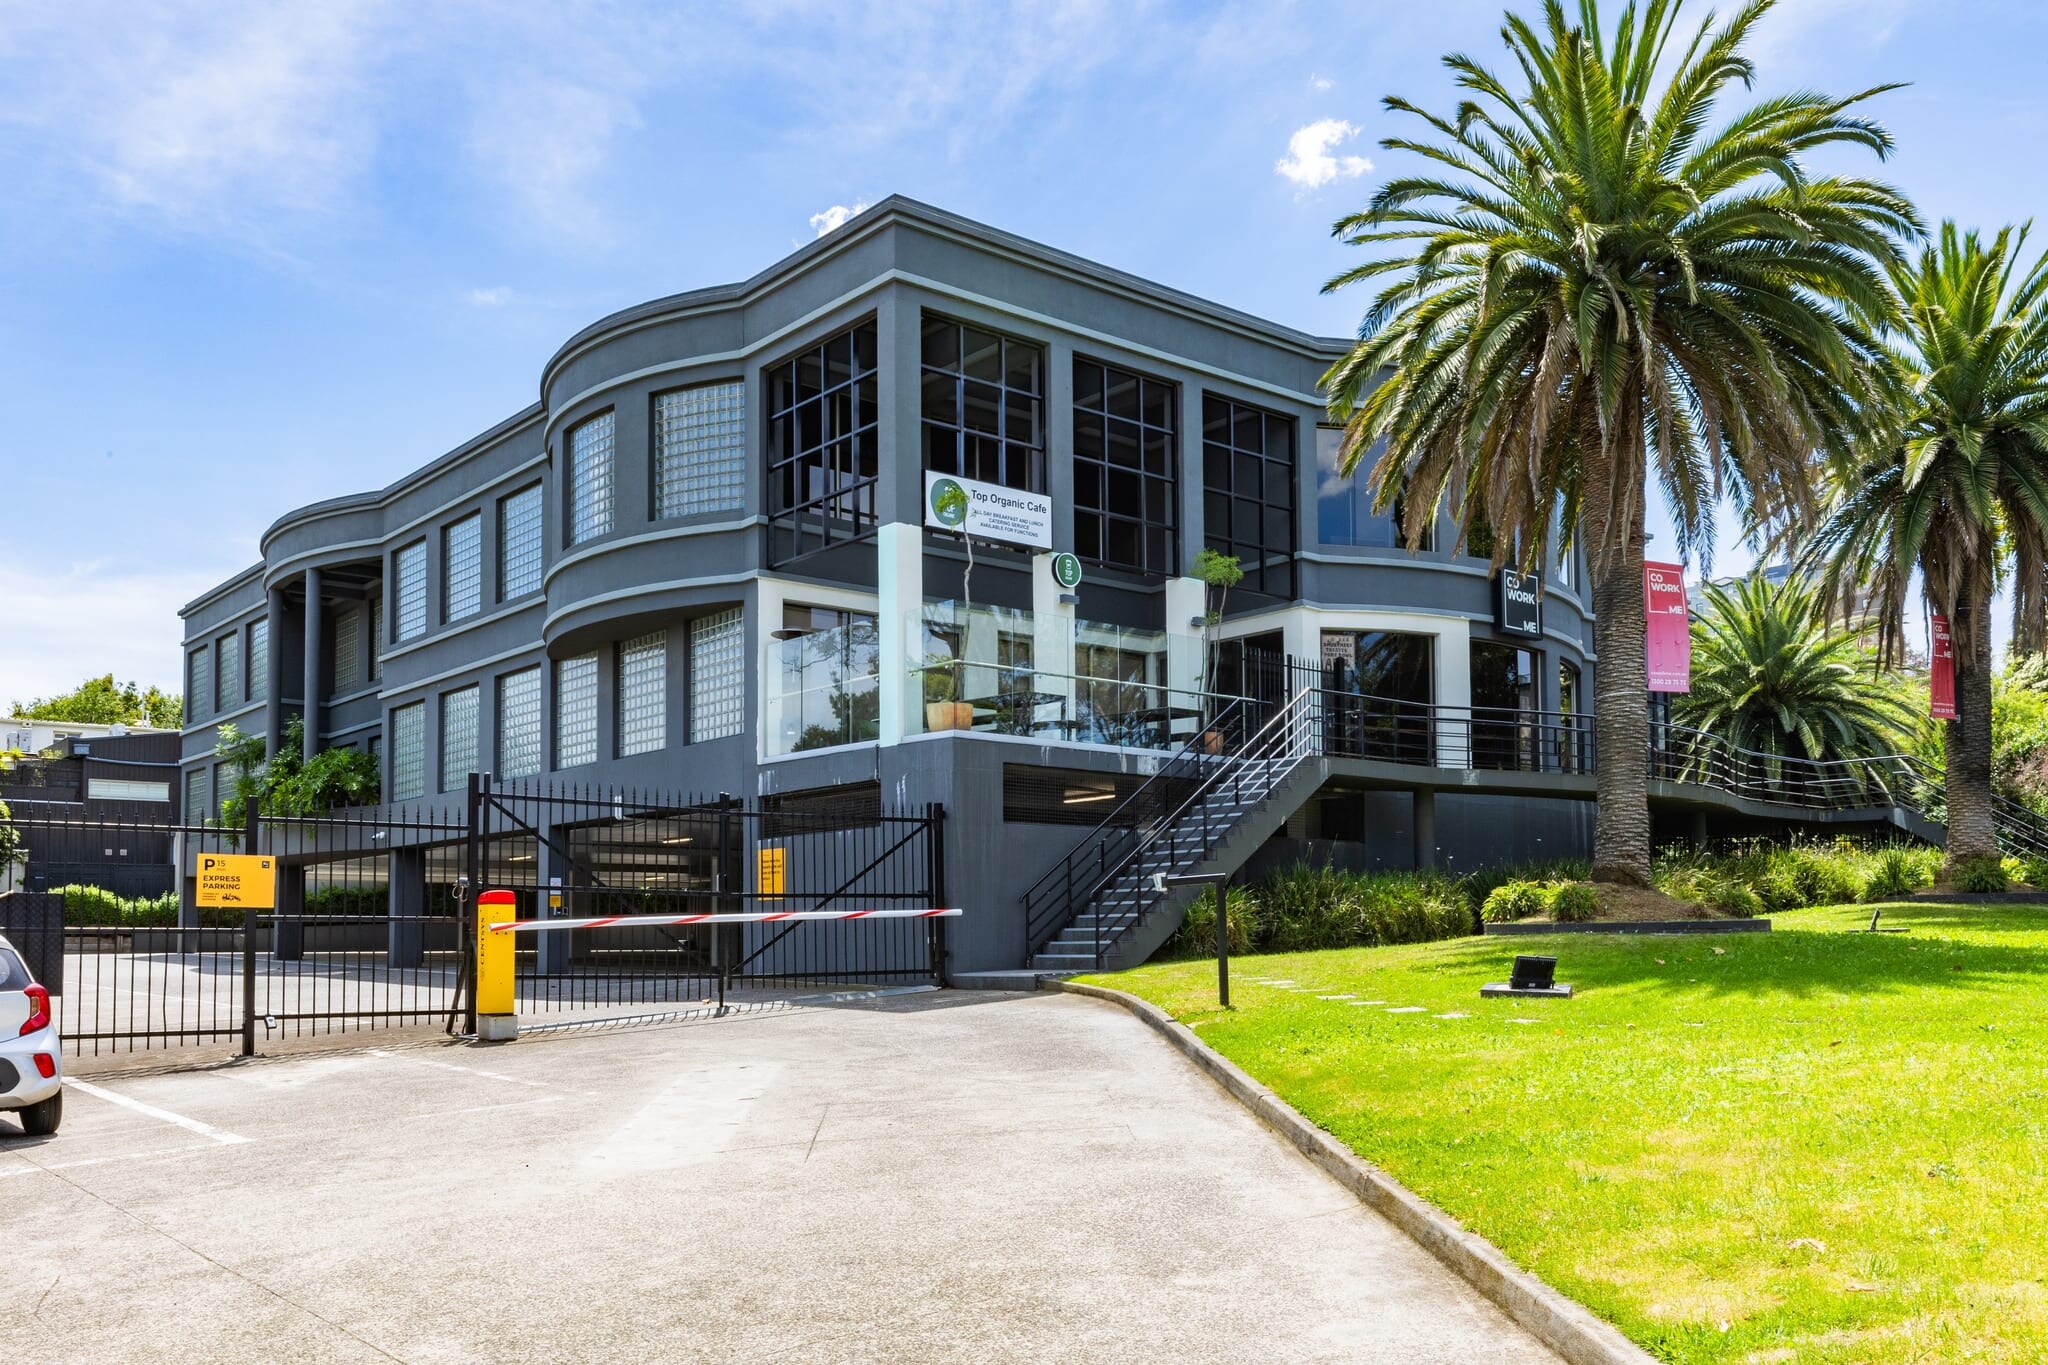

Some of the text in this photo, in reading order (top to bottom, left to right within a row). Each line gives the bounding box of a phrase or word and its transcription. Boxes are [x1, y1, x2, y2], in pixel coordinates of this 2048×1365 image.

[971, 489, 1047, 513] Top Organic Cafe
[993, 512, 1018, 522] BREAKFAST
[980, 522, 1003, 531] AVAILABLE
[1014, 527, 1038, 537] FUNCTIONS
[988, 518, 1029, 530] CATERING SERVICE
[1506, 576, 1520, 589] CO
[1650, 573, 1663, 583] CO
[1650, 582, 1680, 593] WORK
[1506, 588, 1535, 605] WORK
[1668, 604, 1683, 615] ME
[1523, 620, 1537, 633] ME
[1935, 625, 1942, 633] CO
[204, 858, 216, 871] P
[217, 859, 226, 867] 15
